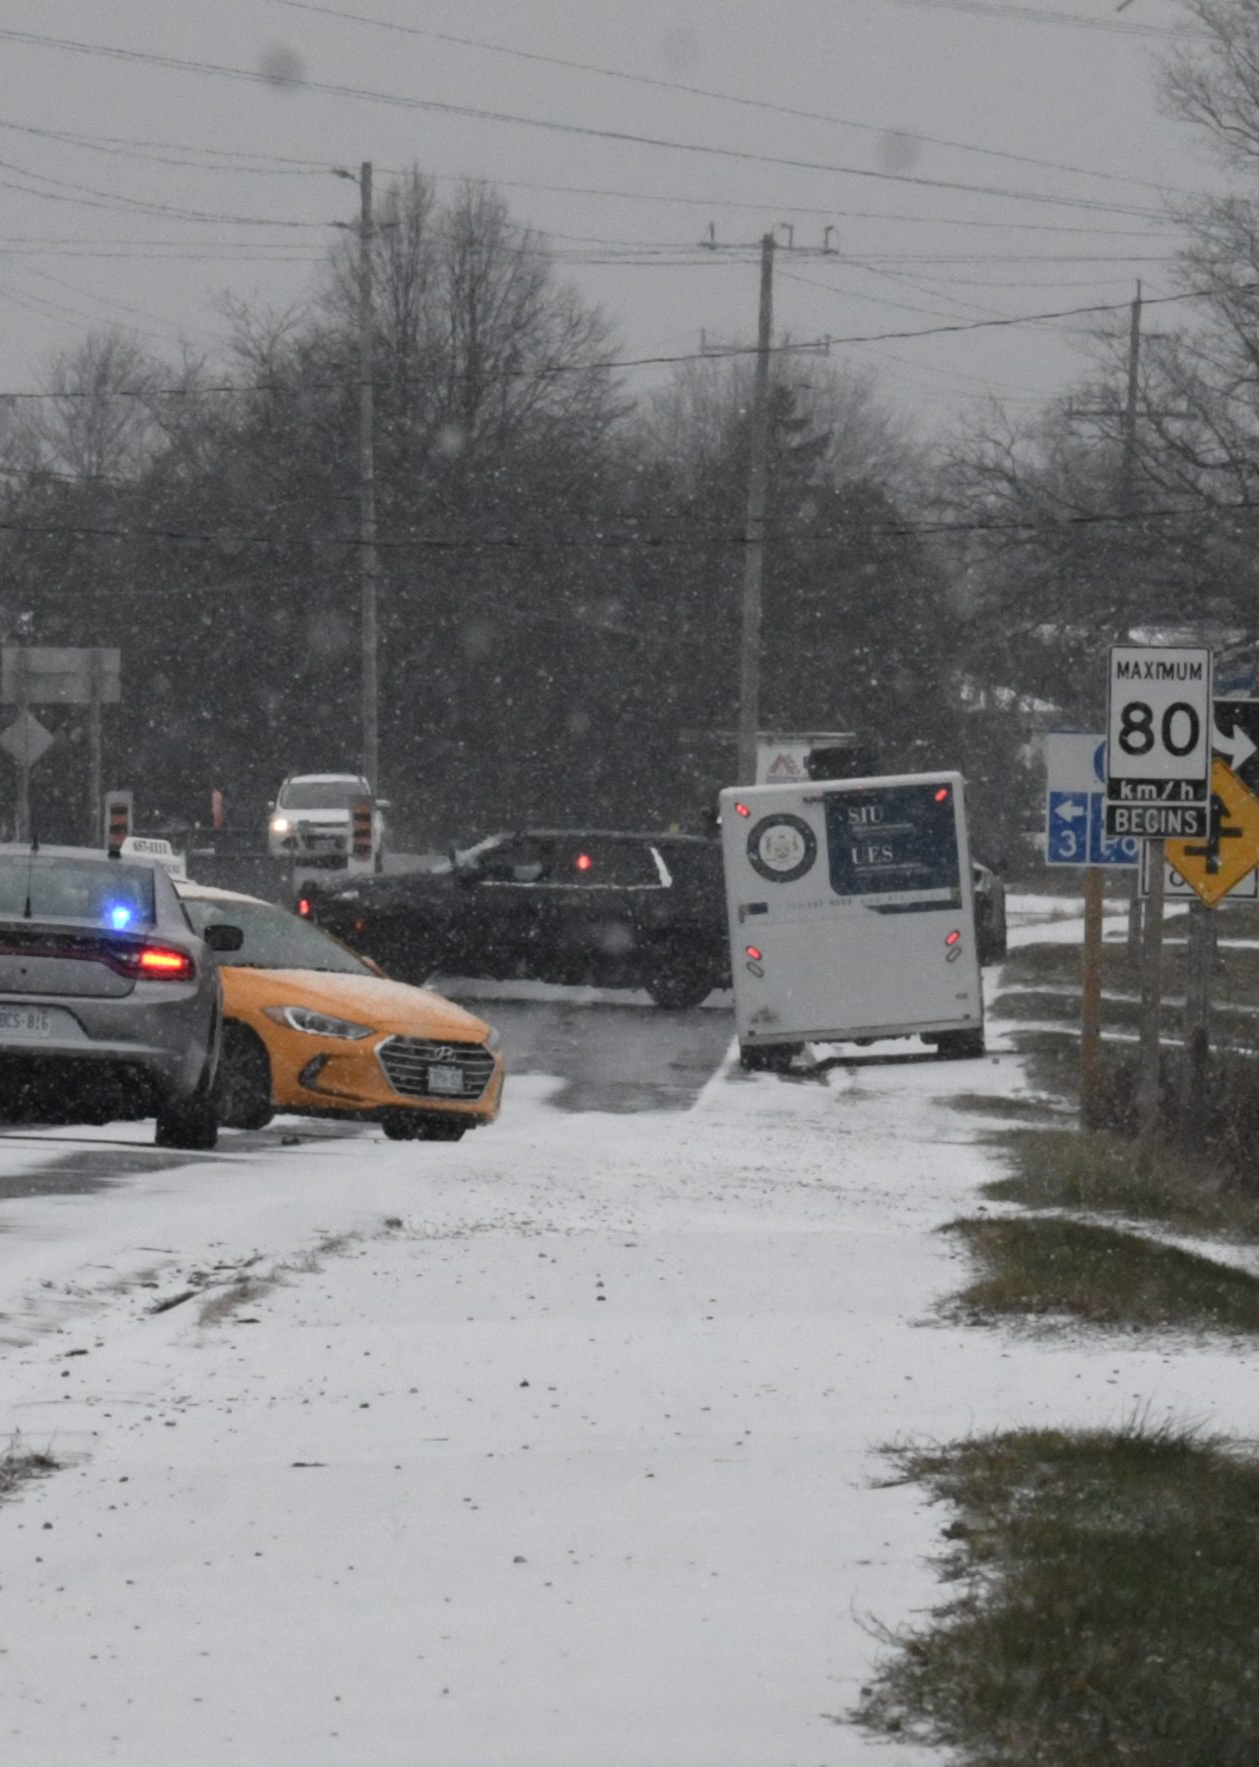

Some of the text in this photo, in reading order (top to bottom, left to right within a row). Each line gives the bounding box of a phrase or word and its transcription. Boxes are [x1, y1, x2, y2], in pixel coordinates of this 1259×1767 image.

[1116, 661, 1202, 681] MAXIMUM
[1118, 701, 1200, 757] 80
[1120, 780, 1194, 800] km/h
[847, 805, 884, 825] SIU
[1115, 808, 1198, 834] BEGINS
[1058, 831, 1077, 857] 3
[851, 846, 894, 864] UES
